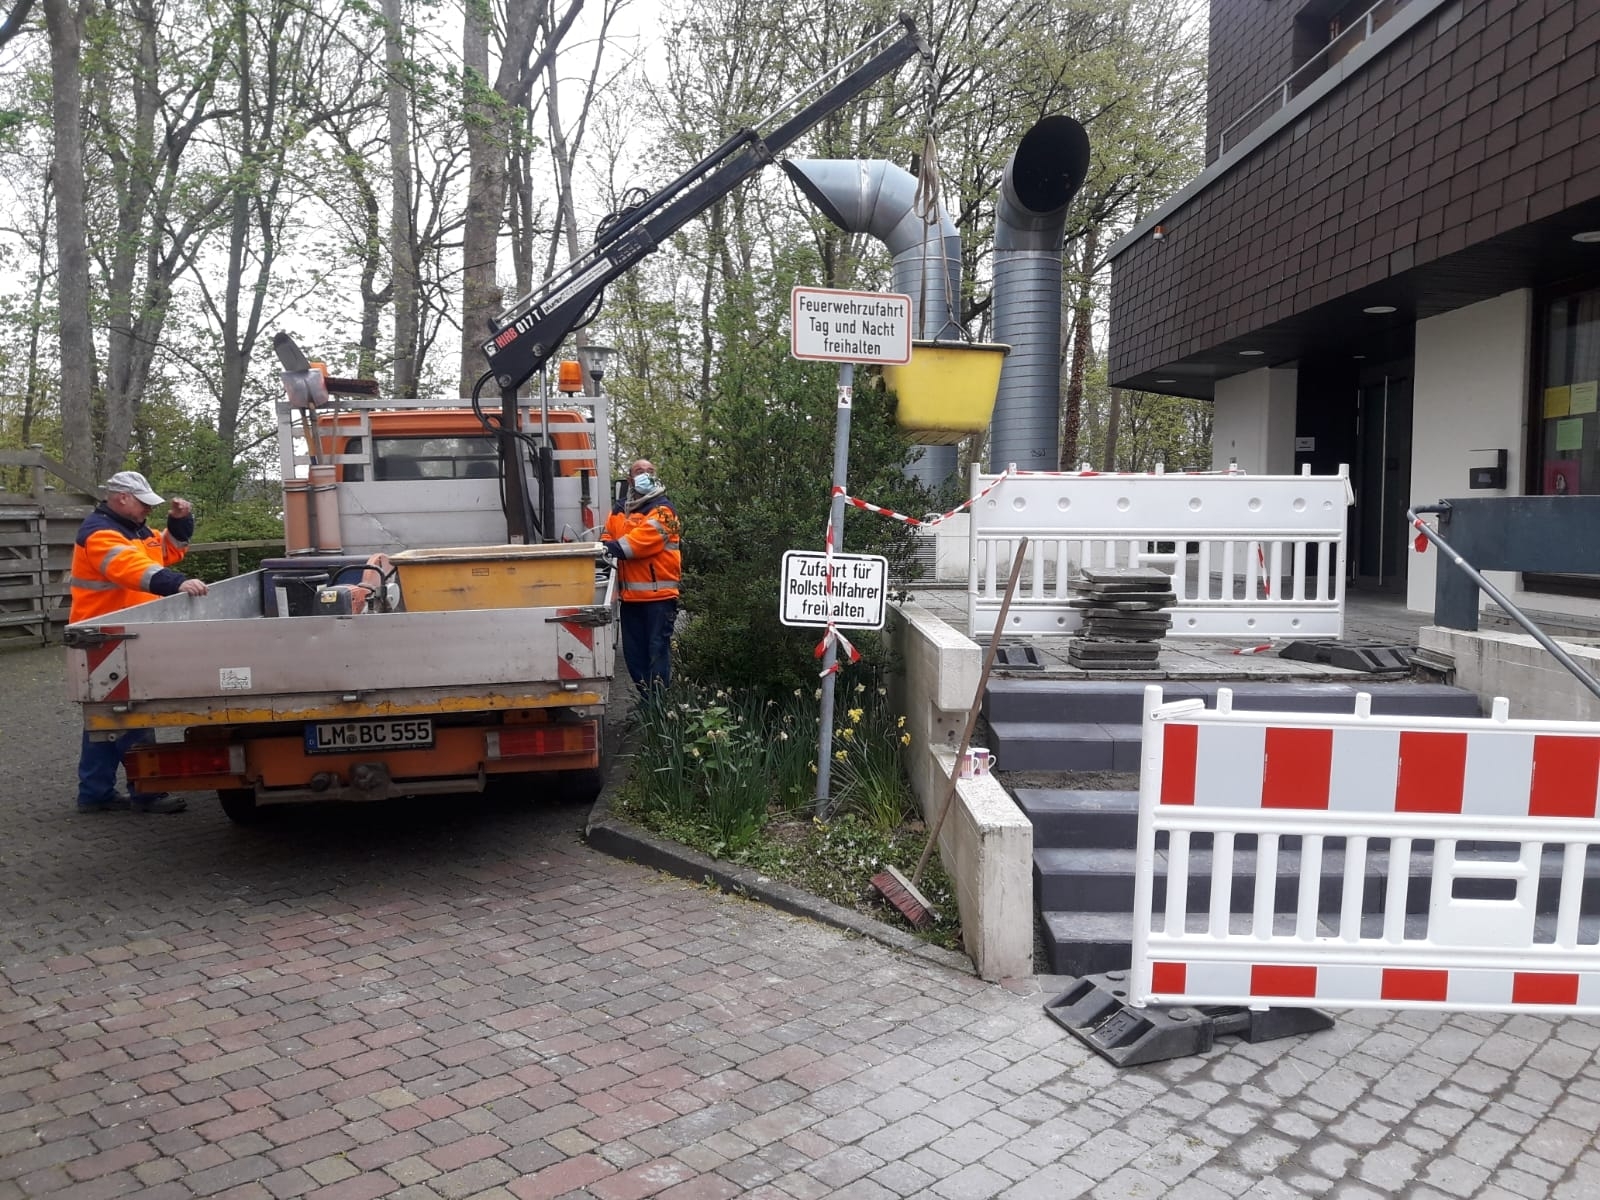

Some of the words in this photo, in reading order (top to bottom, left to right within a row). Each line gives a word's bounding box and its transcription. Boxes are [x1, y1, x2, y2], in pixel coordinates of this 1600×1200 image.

[799, 296, 904, 318] Feuerwehrzufahrt
[495, 327, 518, 348] HIAB
[515, 314, 534, 334] 017
[532, 309, 541, 321] T
[809, 317, 829, 336] Tag
[835, 320, 856, 334] und
[862, 320, 895, 336] Nacht
[824, 338, 881, 355] freihalten
[853, 563, 872, 579] für
[318, 726, 346, 746] LM
[360, 724, 387, 744] BC
[391, 722, 430, 741] 555
